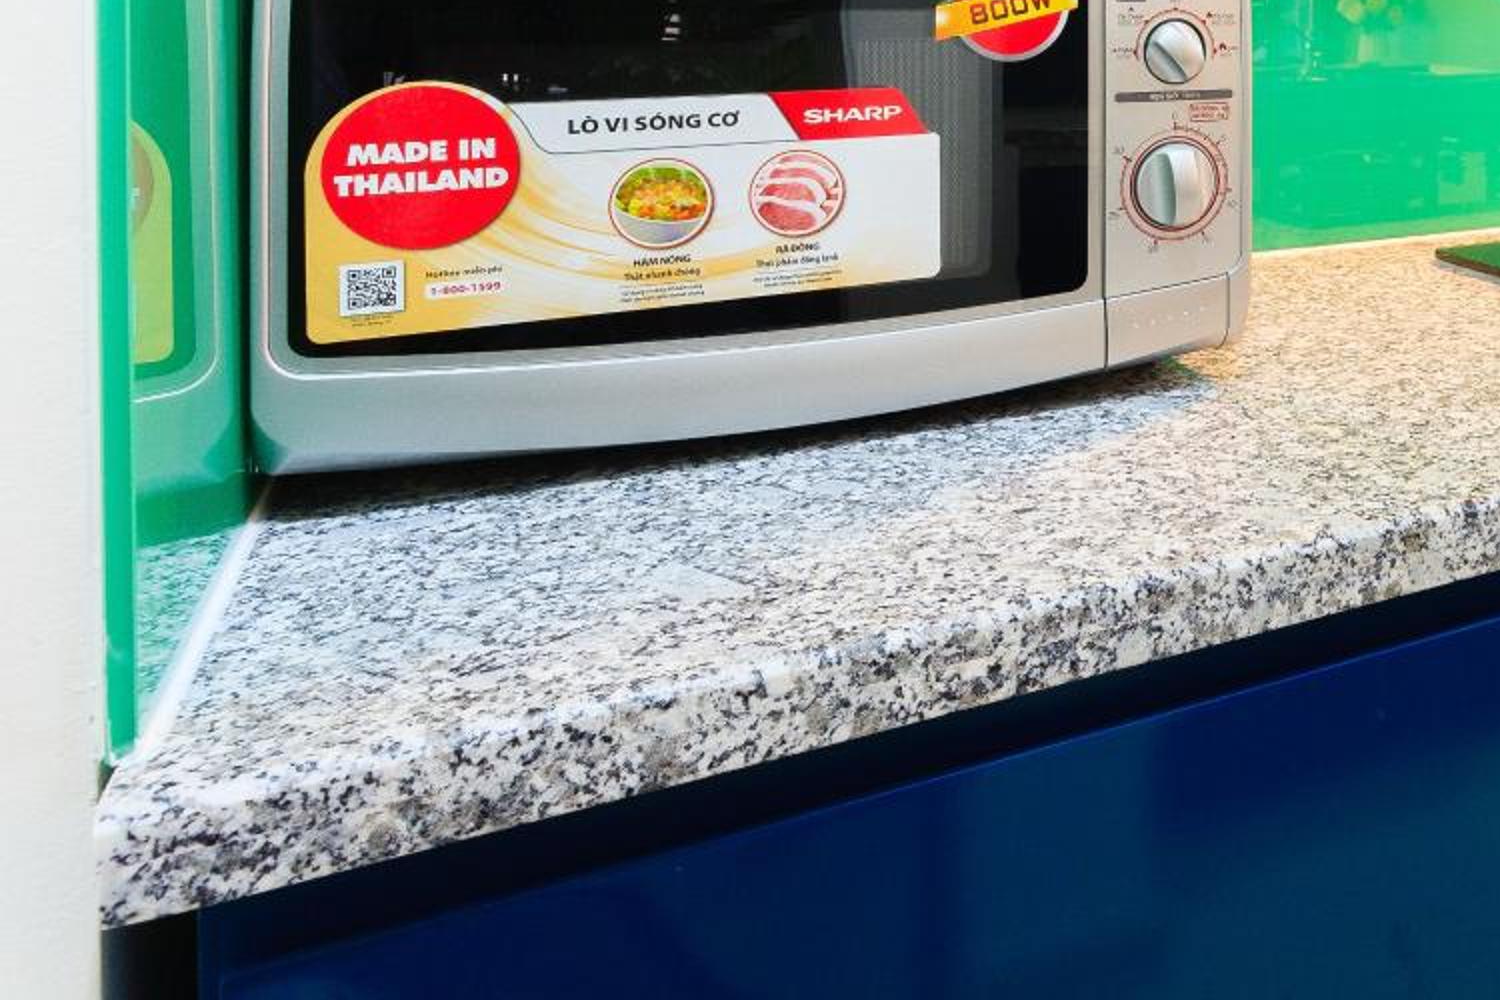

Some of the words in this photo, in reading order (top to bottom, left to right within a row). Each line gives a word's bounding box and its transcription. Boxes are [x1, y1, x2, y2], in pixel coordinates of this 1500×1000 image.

[567, 115, 599, 135] LÒ
[605, 117, 628, 133] VI
[635, 112, 701, 132] SÓNG
[708, 110, 740, 128] CƠ
[803, 105, 903, 125] SHARP
[346, 139, 448, 167] MADE
[458, 137, 497, 160] IN
[333, 167, 510, 197] THAILAND
